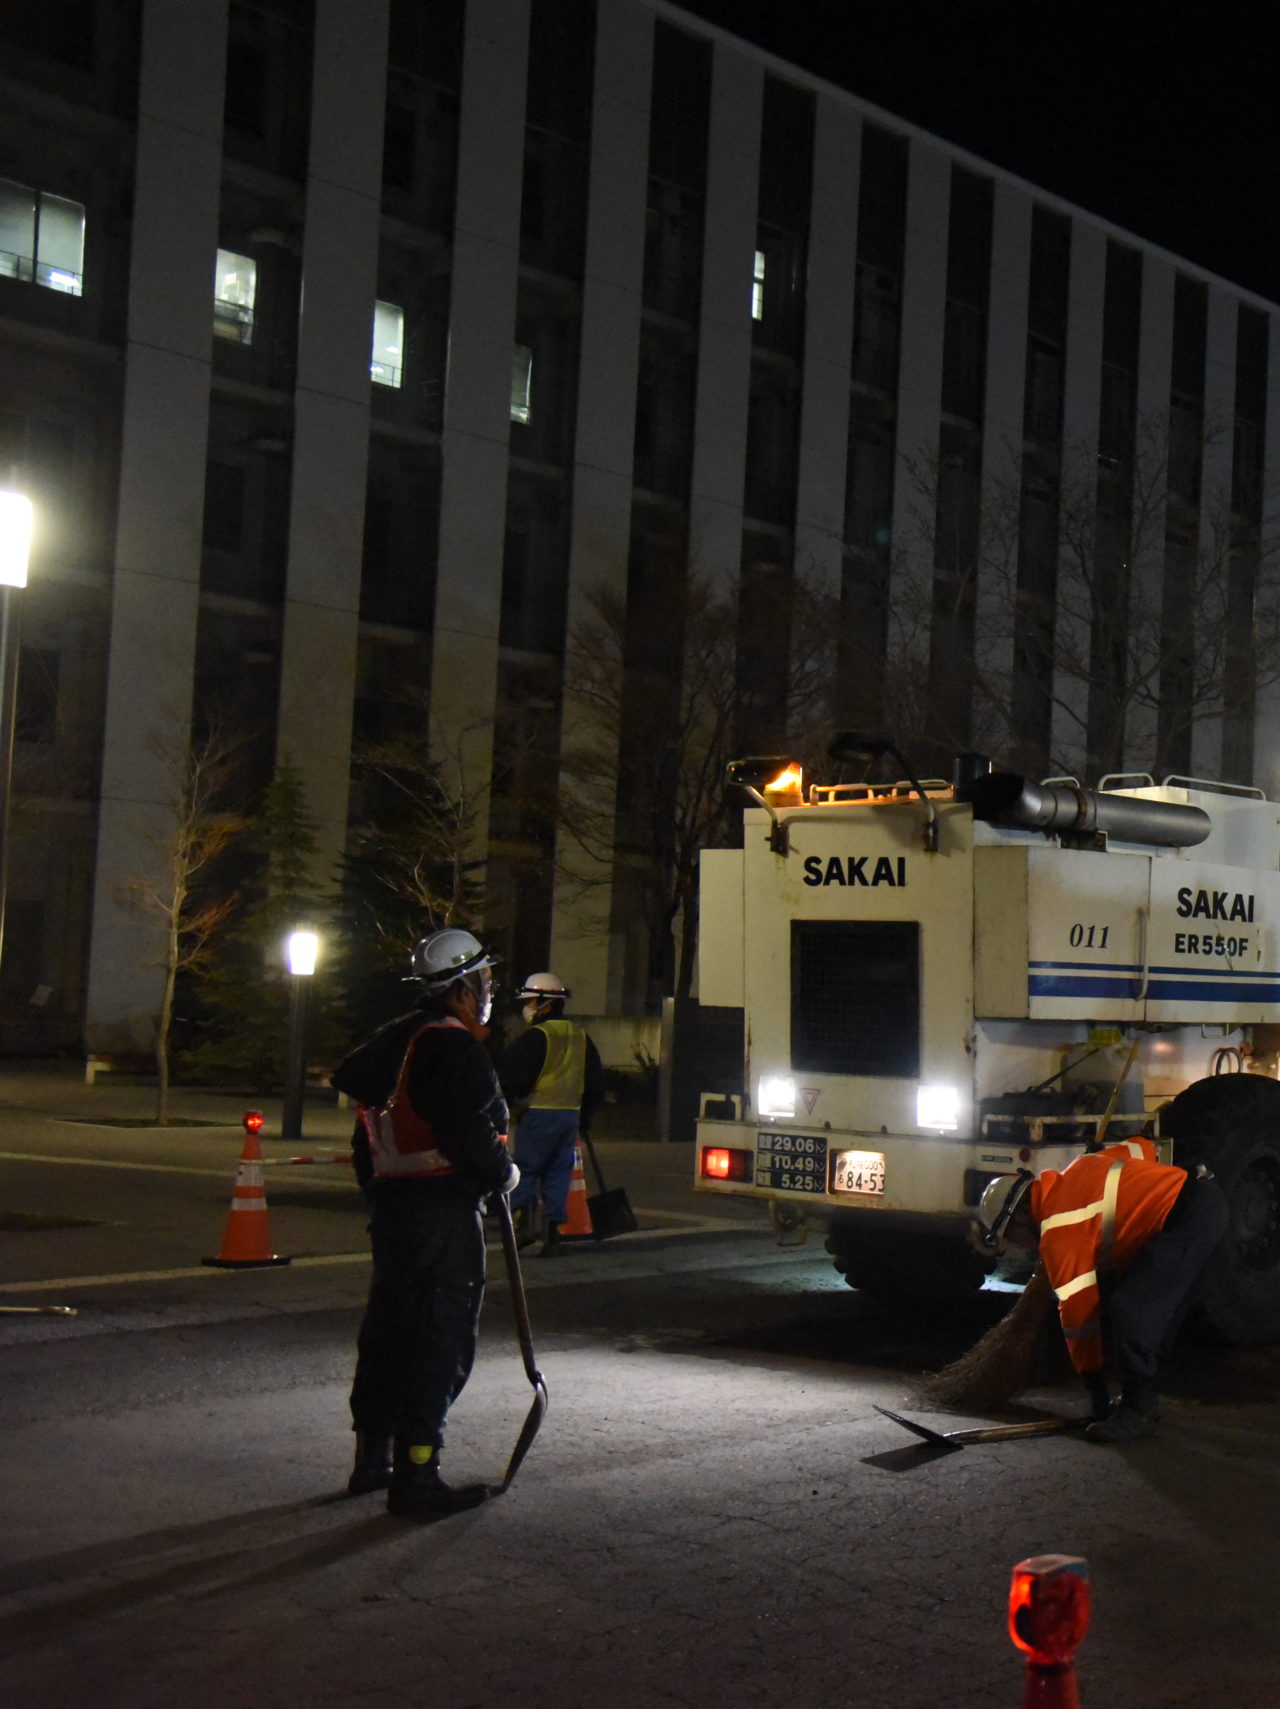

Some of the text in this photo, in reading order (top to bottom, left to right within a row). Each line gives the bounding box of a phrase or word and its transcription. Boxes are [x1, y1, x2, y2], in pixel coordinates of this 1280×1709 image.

[802, 855, 906, 887] SAKAI
[1176, 887, 1255, 923] SAKAI
[1069, 923, 1109, 949] 011
[1174, 932, 1249, 957] ER550F
